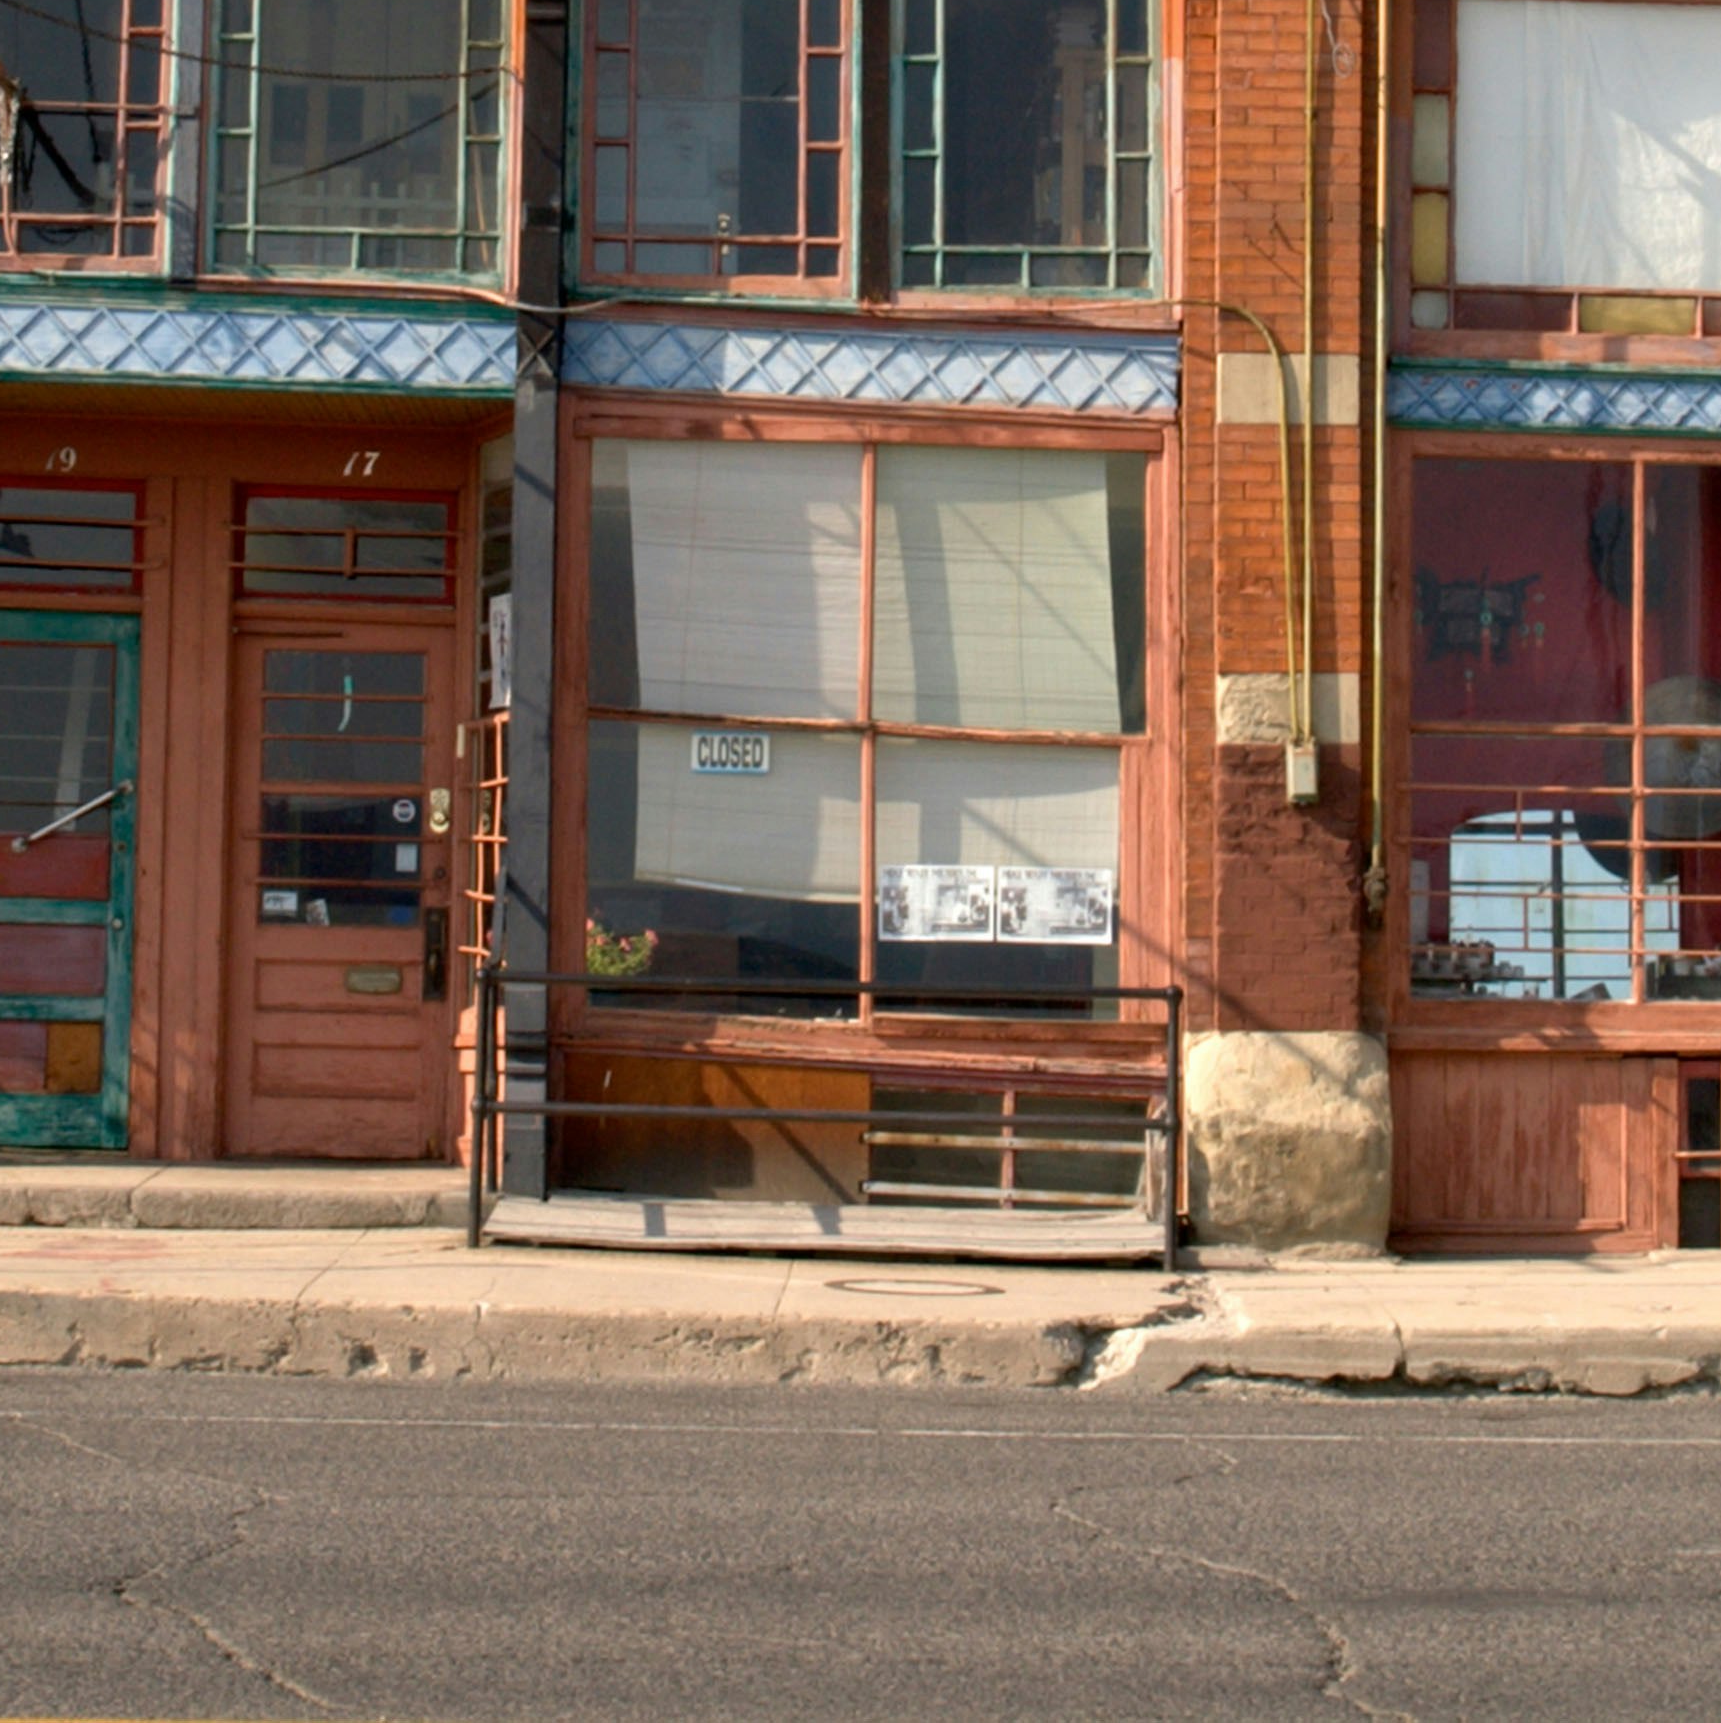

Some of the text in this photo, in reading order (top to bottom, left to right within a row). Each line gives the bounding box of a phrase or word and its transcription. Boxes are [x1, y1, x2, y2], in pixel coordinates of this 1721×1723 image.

[45, 445, 77, 473] 19
[342, 450, 381, 477] 17
[698, 736, 764, 767] CLOSED
